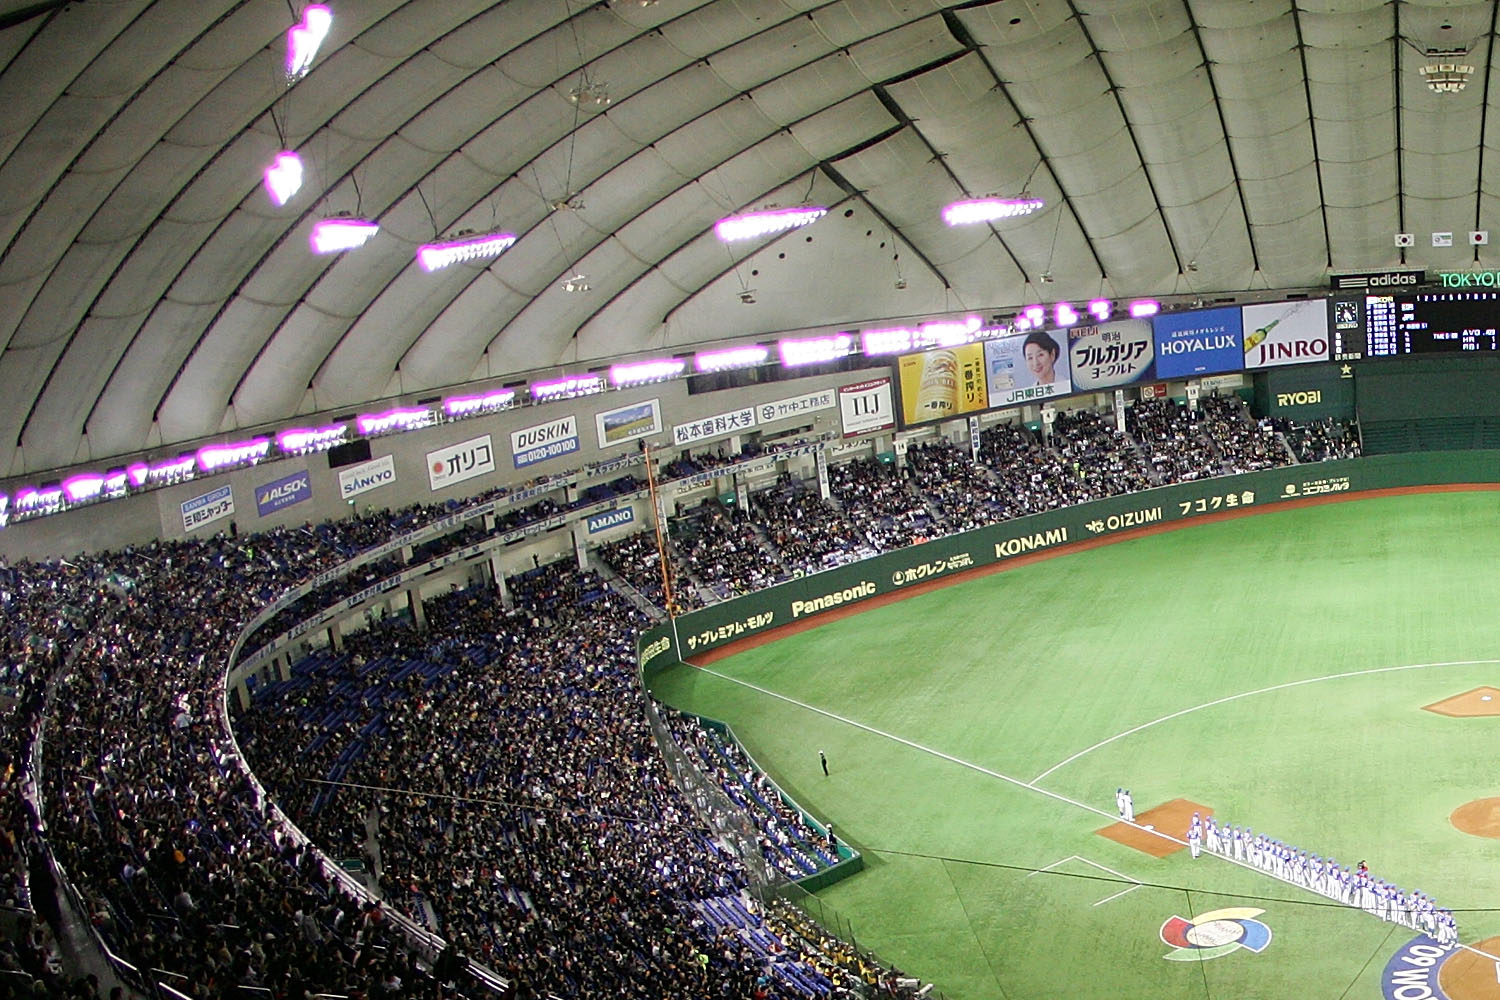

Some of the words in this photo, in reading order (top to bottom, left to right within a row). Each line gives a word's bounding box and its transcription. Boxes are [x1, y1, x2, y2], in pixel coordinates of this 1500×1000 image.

[1370, 273, 1417, 286] adidas
[1440, 273, 1494, 288] TOKYO
[1101, 331, 1121, 342] 明治
[1161, 335, 1236, 356] HOYALUX
[1077, 340, 1148, 369] ブルガリア
[1259, 339, 1328, 365] JINRO
[1091, 363, 1137, 380] ヨーグルト
[963, 363, 975, 404] 一番搾り
[1007, 385, 1055, 403] JR東日本
[777, 395, 831, 416] 竹中工務店
[852, 393, 882, 416] IIJ
[1277, 391, 1321, 407] RYOBI
[517, 422, 570, 449] DUSKIN
[676, 410, 753, 442] 松本歯科大学
[447, 445, 491, 476] オリコ
[269, 478, 308, 500] ALSOK
[343, 469, 393, 494] SANKYO
[1303, 482, 1350, 496] コニカミノルタ
[184, 500, 233, 527] 三和シャッター
[1179, 491, 1255, 516] フコク生命
[590, 510, 632, 532] AMANO
[1107, 507, 1162, 530] OIZUMI
[995, 528, 1068, 558] KONAMI
[905, 560, 947, 581] ホクレン
[792, 581, 876, 617] Panasonic
